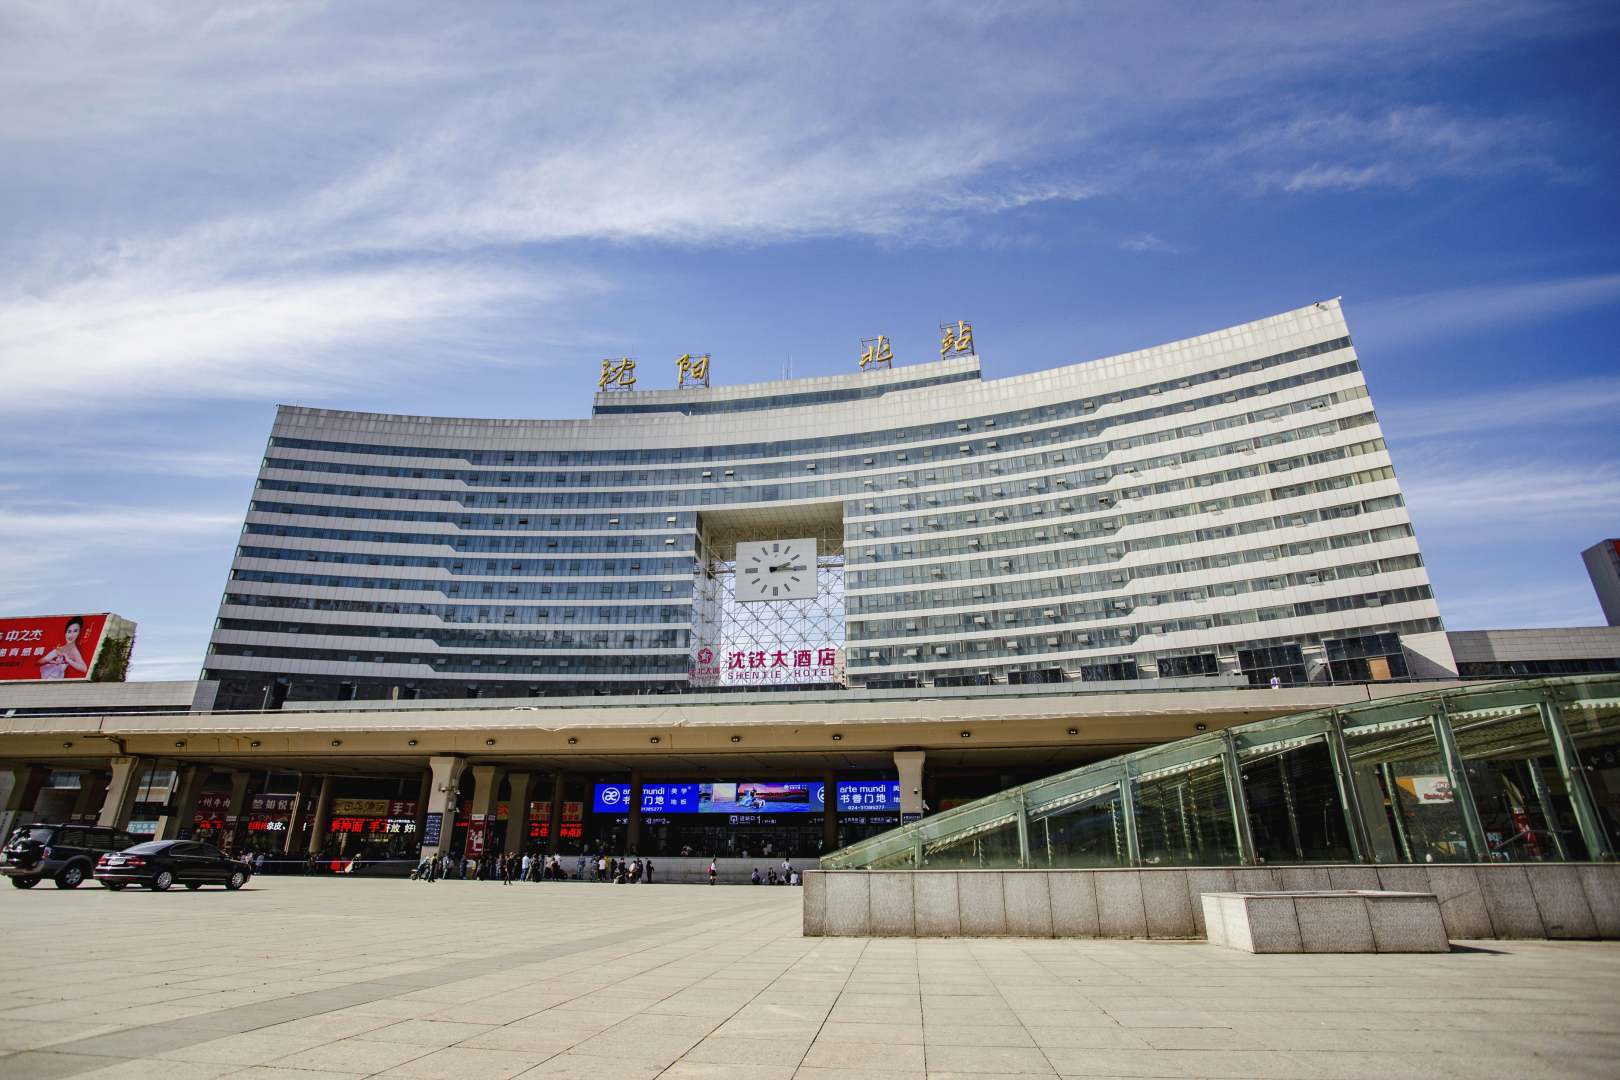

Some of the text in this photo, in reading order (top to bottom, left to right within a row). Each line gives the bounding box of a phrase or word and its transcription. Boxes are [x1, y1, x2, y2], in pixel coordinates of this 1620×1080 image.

[600, 320, 973, 387] 沈阳北站
[727, 648, 836, 670] 沈铁大酒店
[727, 670, 782, 680] SHENTIE
[793, 668, 835, 678] HOTEL
[860, 784, 886, 793] mundi
